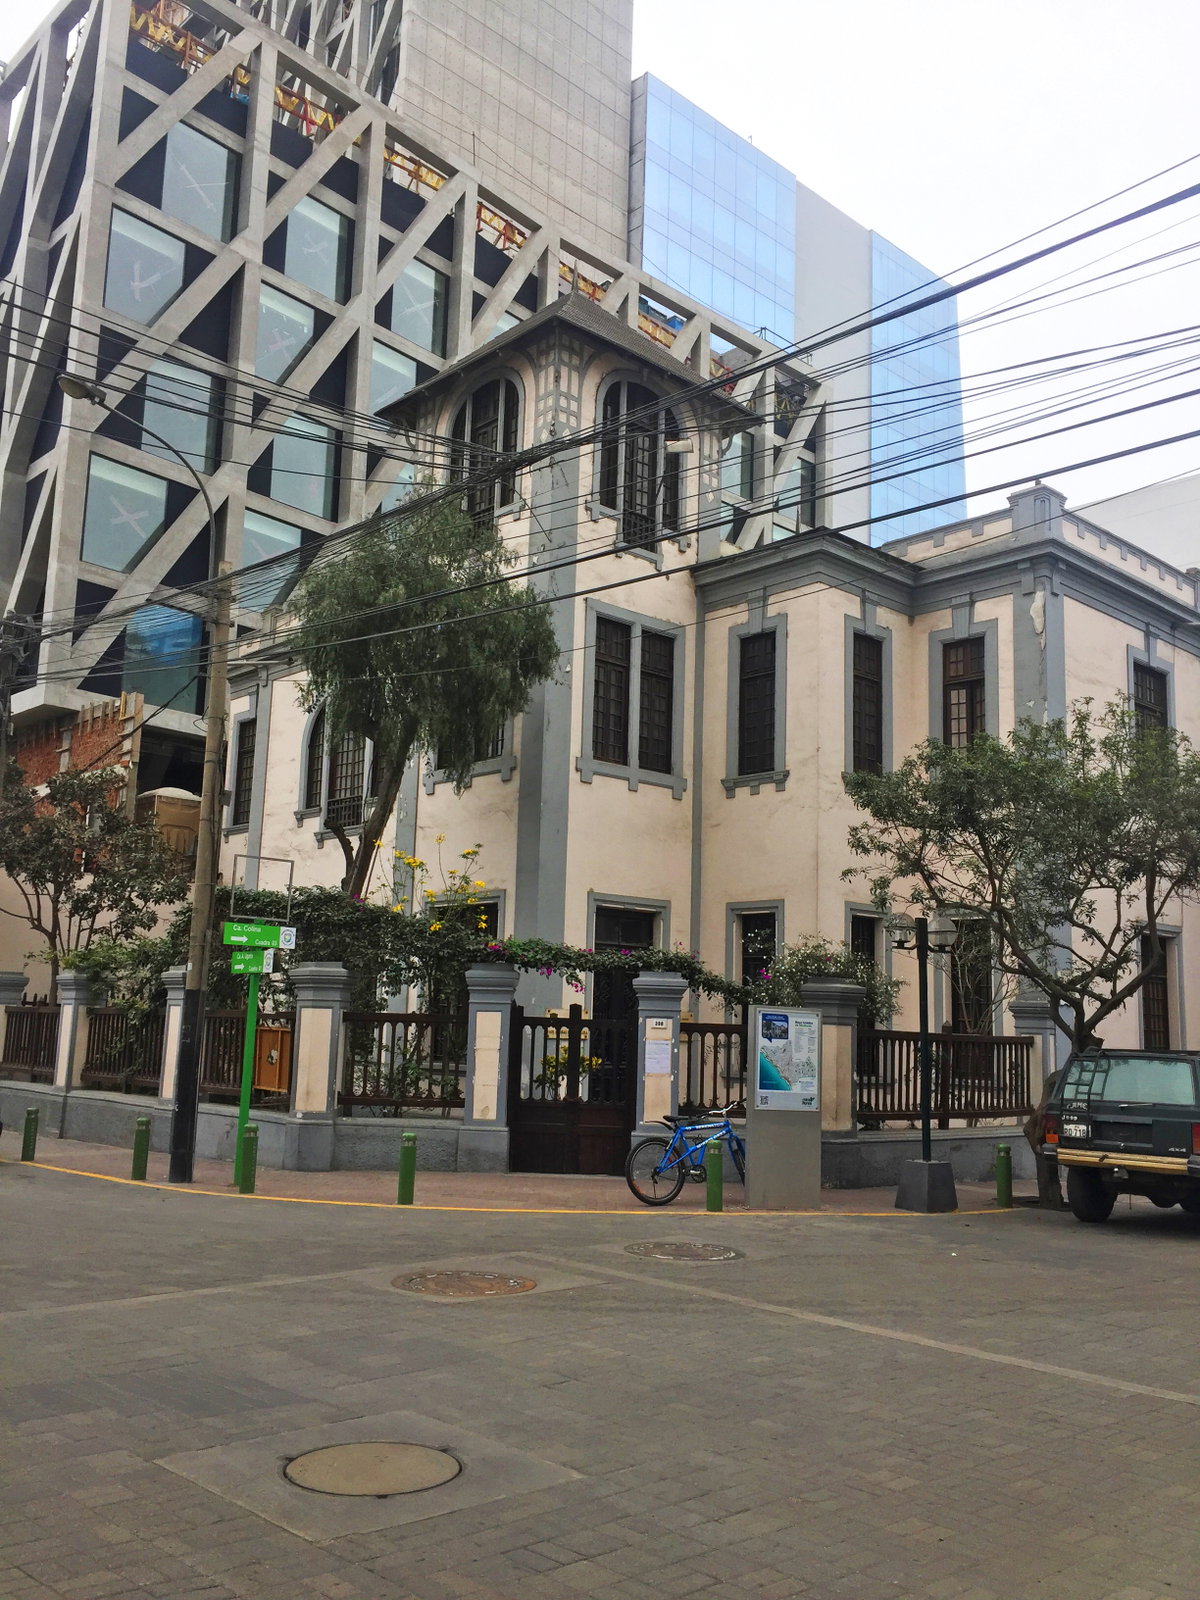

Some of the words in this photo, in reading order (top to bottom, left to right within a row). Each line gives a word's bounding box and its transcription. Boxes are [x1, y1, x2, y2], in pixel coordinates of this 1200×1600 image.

[233, 924, 242, 932] Ca.
[243, 925, 262, 933] Colina
[254, 938, 271, 946] Cuadra
